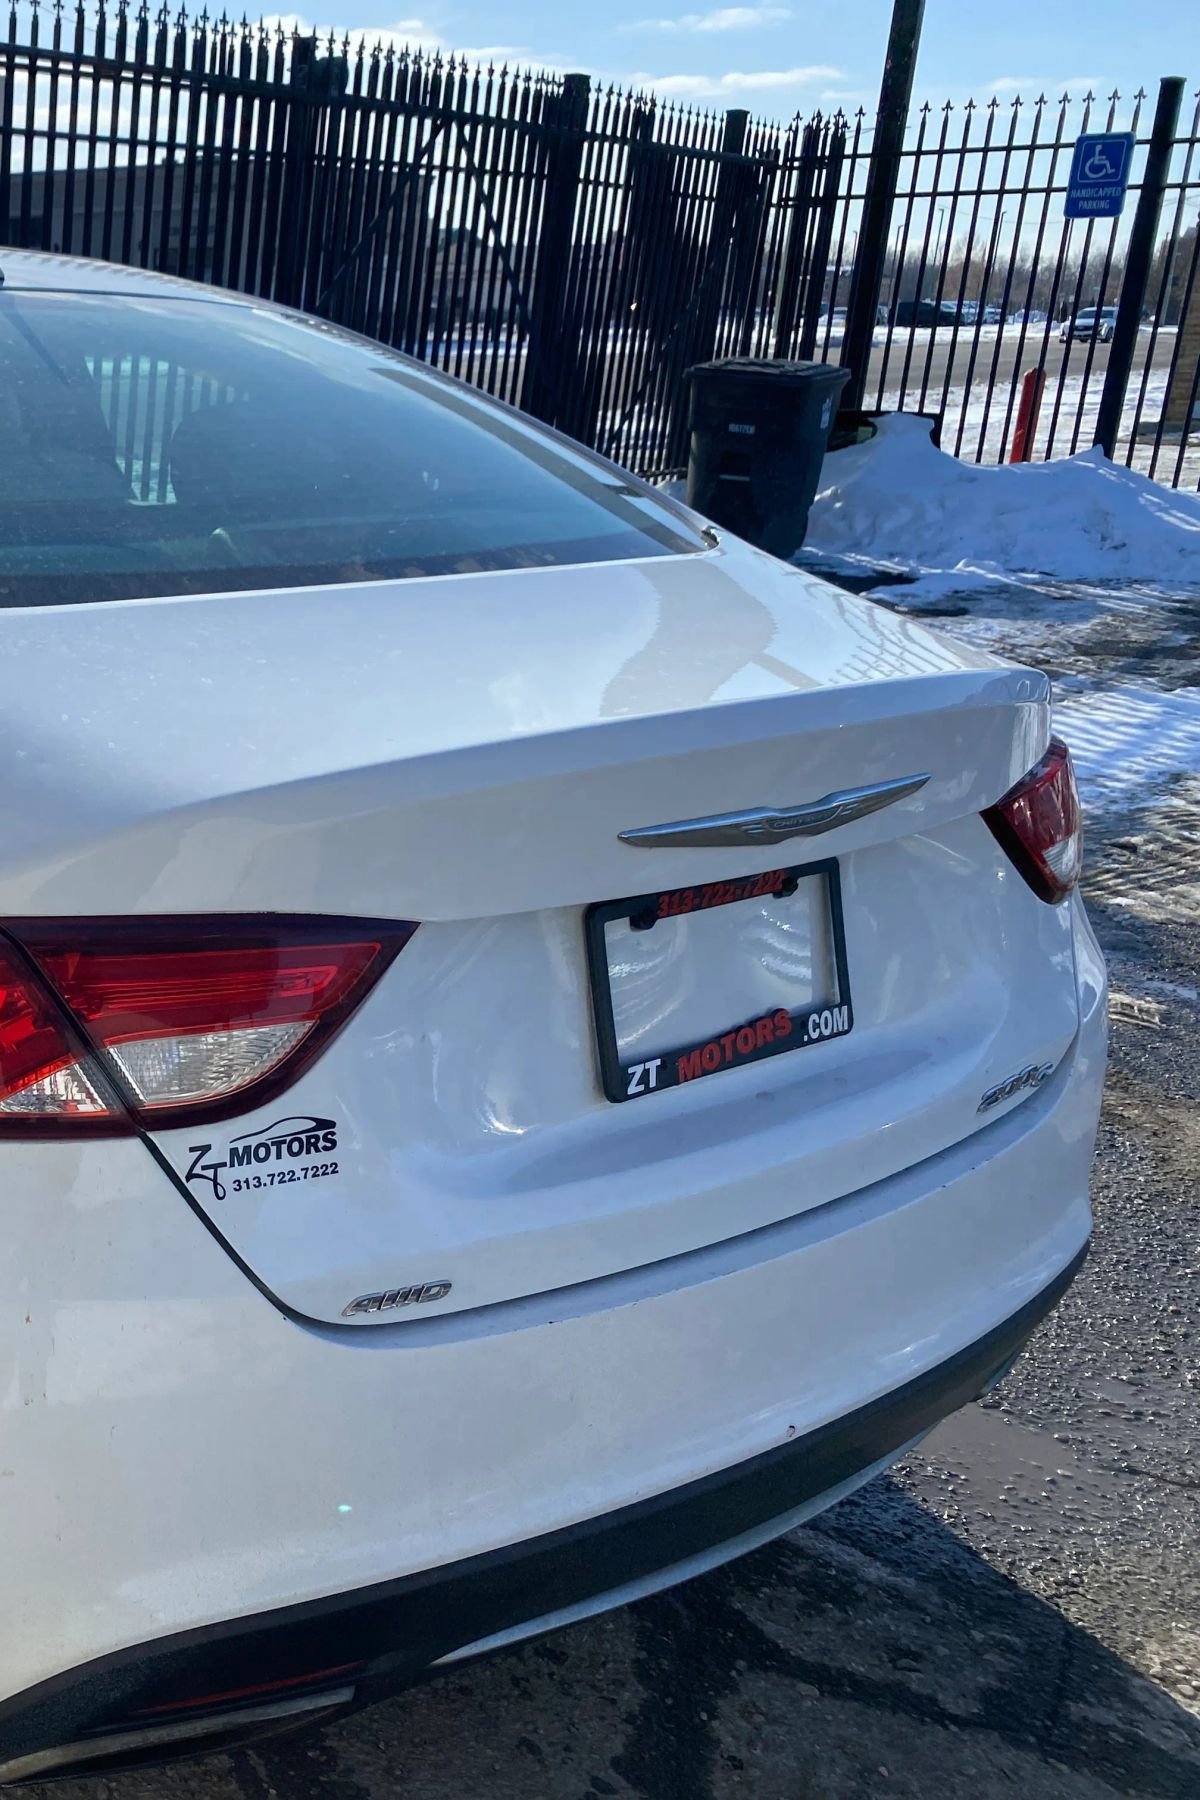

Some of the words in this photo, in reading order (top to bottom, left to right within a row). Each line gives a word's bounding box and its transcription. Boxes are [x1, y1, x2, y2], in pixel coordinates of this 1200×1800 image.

[1071, 187, 1122, 198] HANDICAPPED
[1078, 200, 1110, 210] PARKING
[627, 1058, 661, 1095] ZT
[677, 1007, 792, 1083] MOTORS
[803, 1005, 849, 1042] .COM
[229, 1131, 337, 1168] MOTORS
[232, 1162, 339, 1192] 313.722.7222
[341, 1279, 452, 1317] AWD
